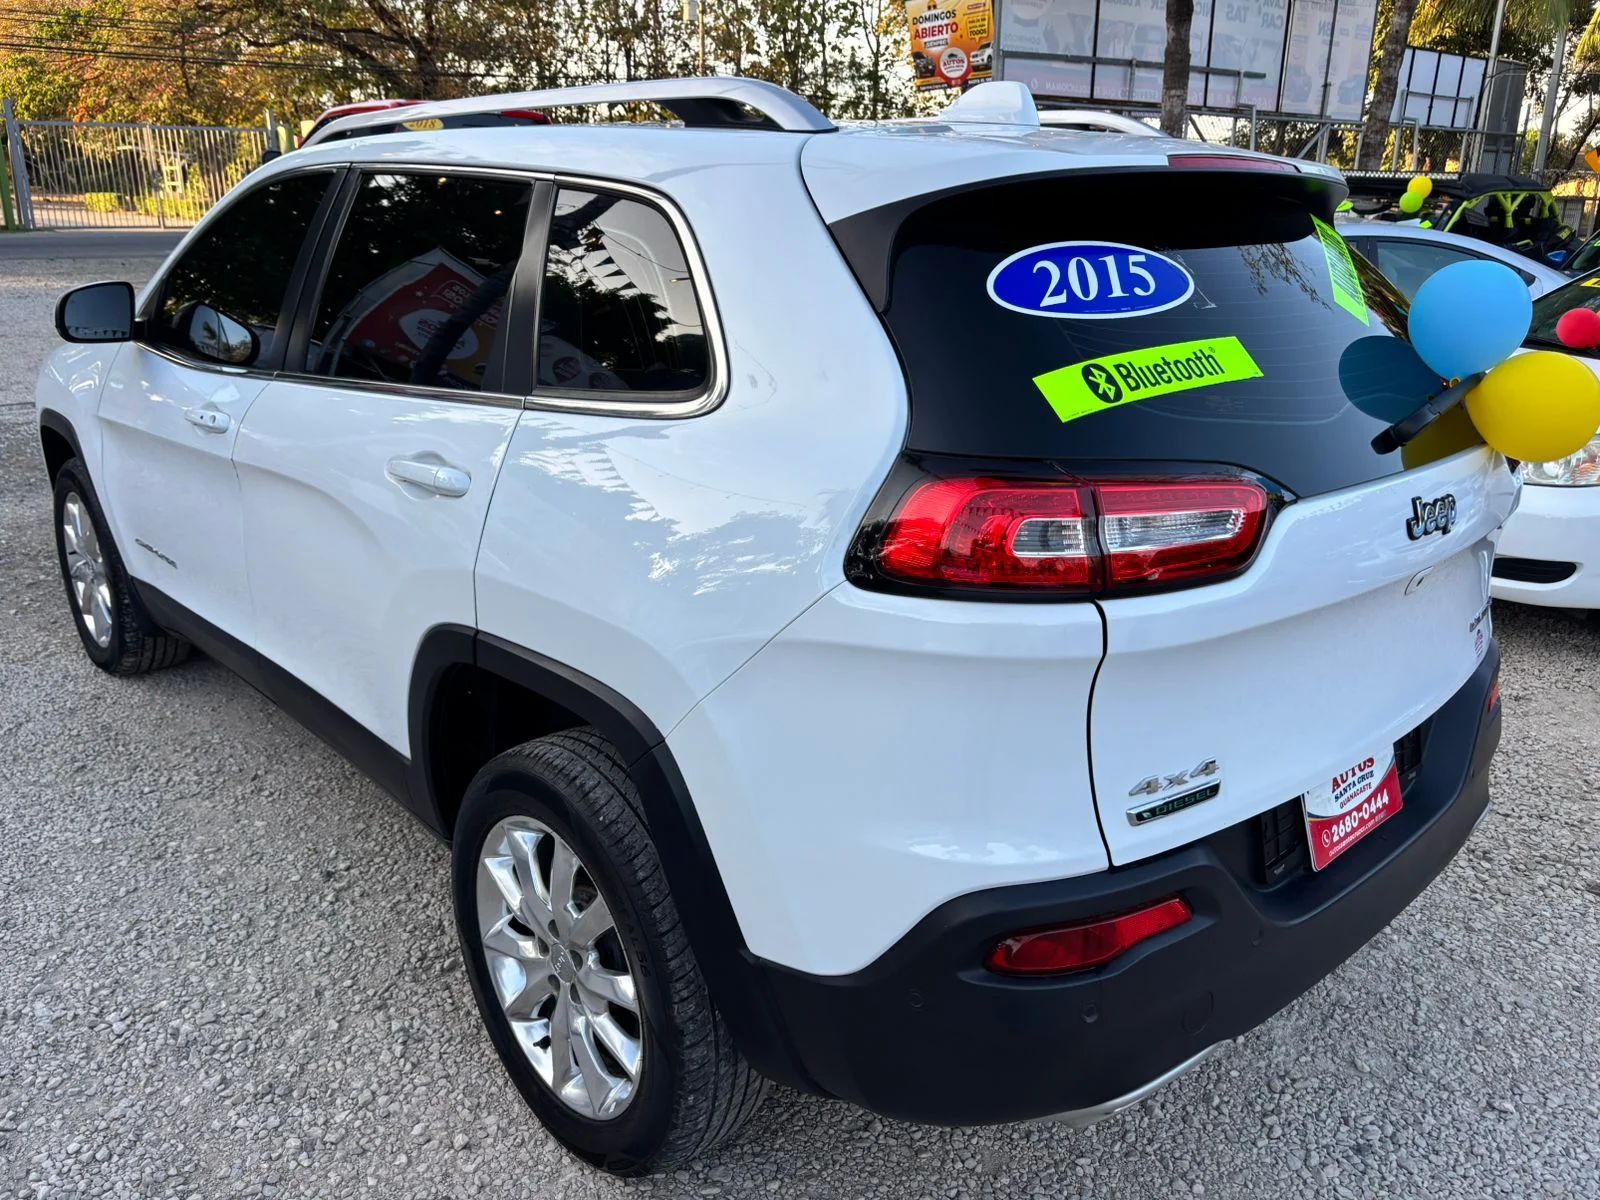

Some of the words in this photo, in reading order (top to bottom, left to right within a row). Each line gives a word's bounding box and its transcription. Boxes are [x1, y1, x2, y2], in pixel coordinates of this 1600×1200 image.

[912, 9, 957, 26] DOMINGOS
[914, 22, 959, 40] ABIERTO
[943, 58, 965, 68] AUTOS
[1033, 253, 1157, 307] 2015
[1406, 493, 1457, 541] Jeep
[1334, 780, 1357, 803] SANTA
[1357, 769, 1375, 785] CRUZ
[1155, 788, 1217, 815] DIESEL
[1331, 788, 1389, 843] 2680-0444
